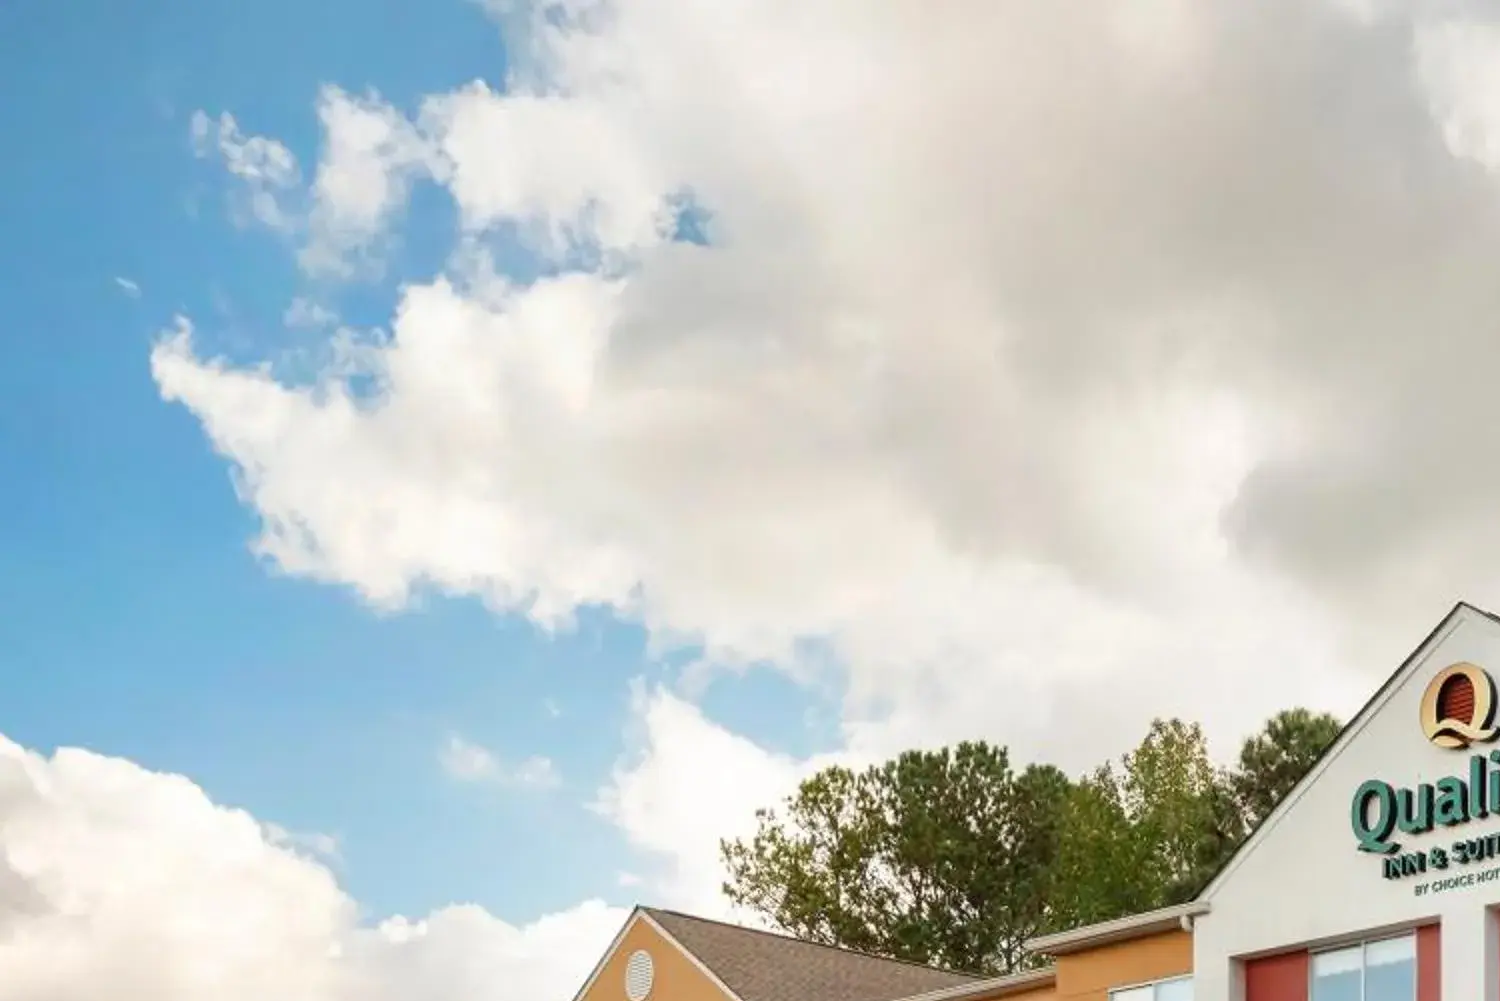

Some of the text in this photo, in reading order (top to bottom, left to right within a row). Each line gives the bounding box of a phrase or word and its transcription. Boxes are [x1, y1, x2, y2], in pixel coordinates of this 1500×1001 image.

[1383, 852, 1427, 880] INN
[1428, 847, 1449, 870] &
[1414, 883, 1429, 896] BY
[1431, 873, 1475, 892] CHOICE
